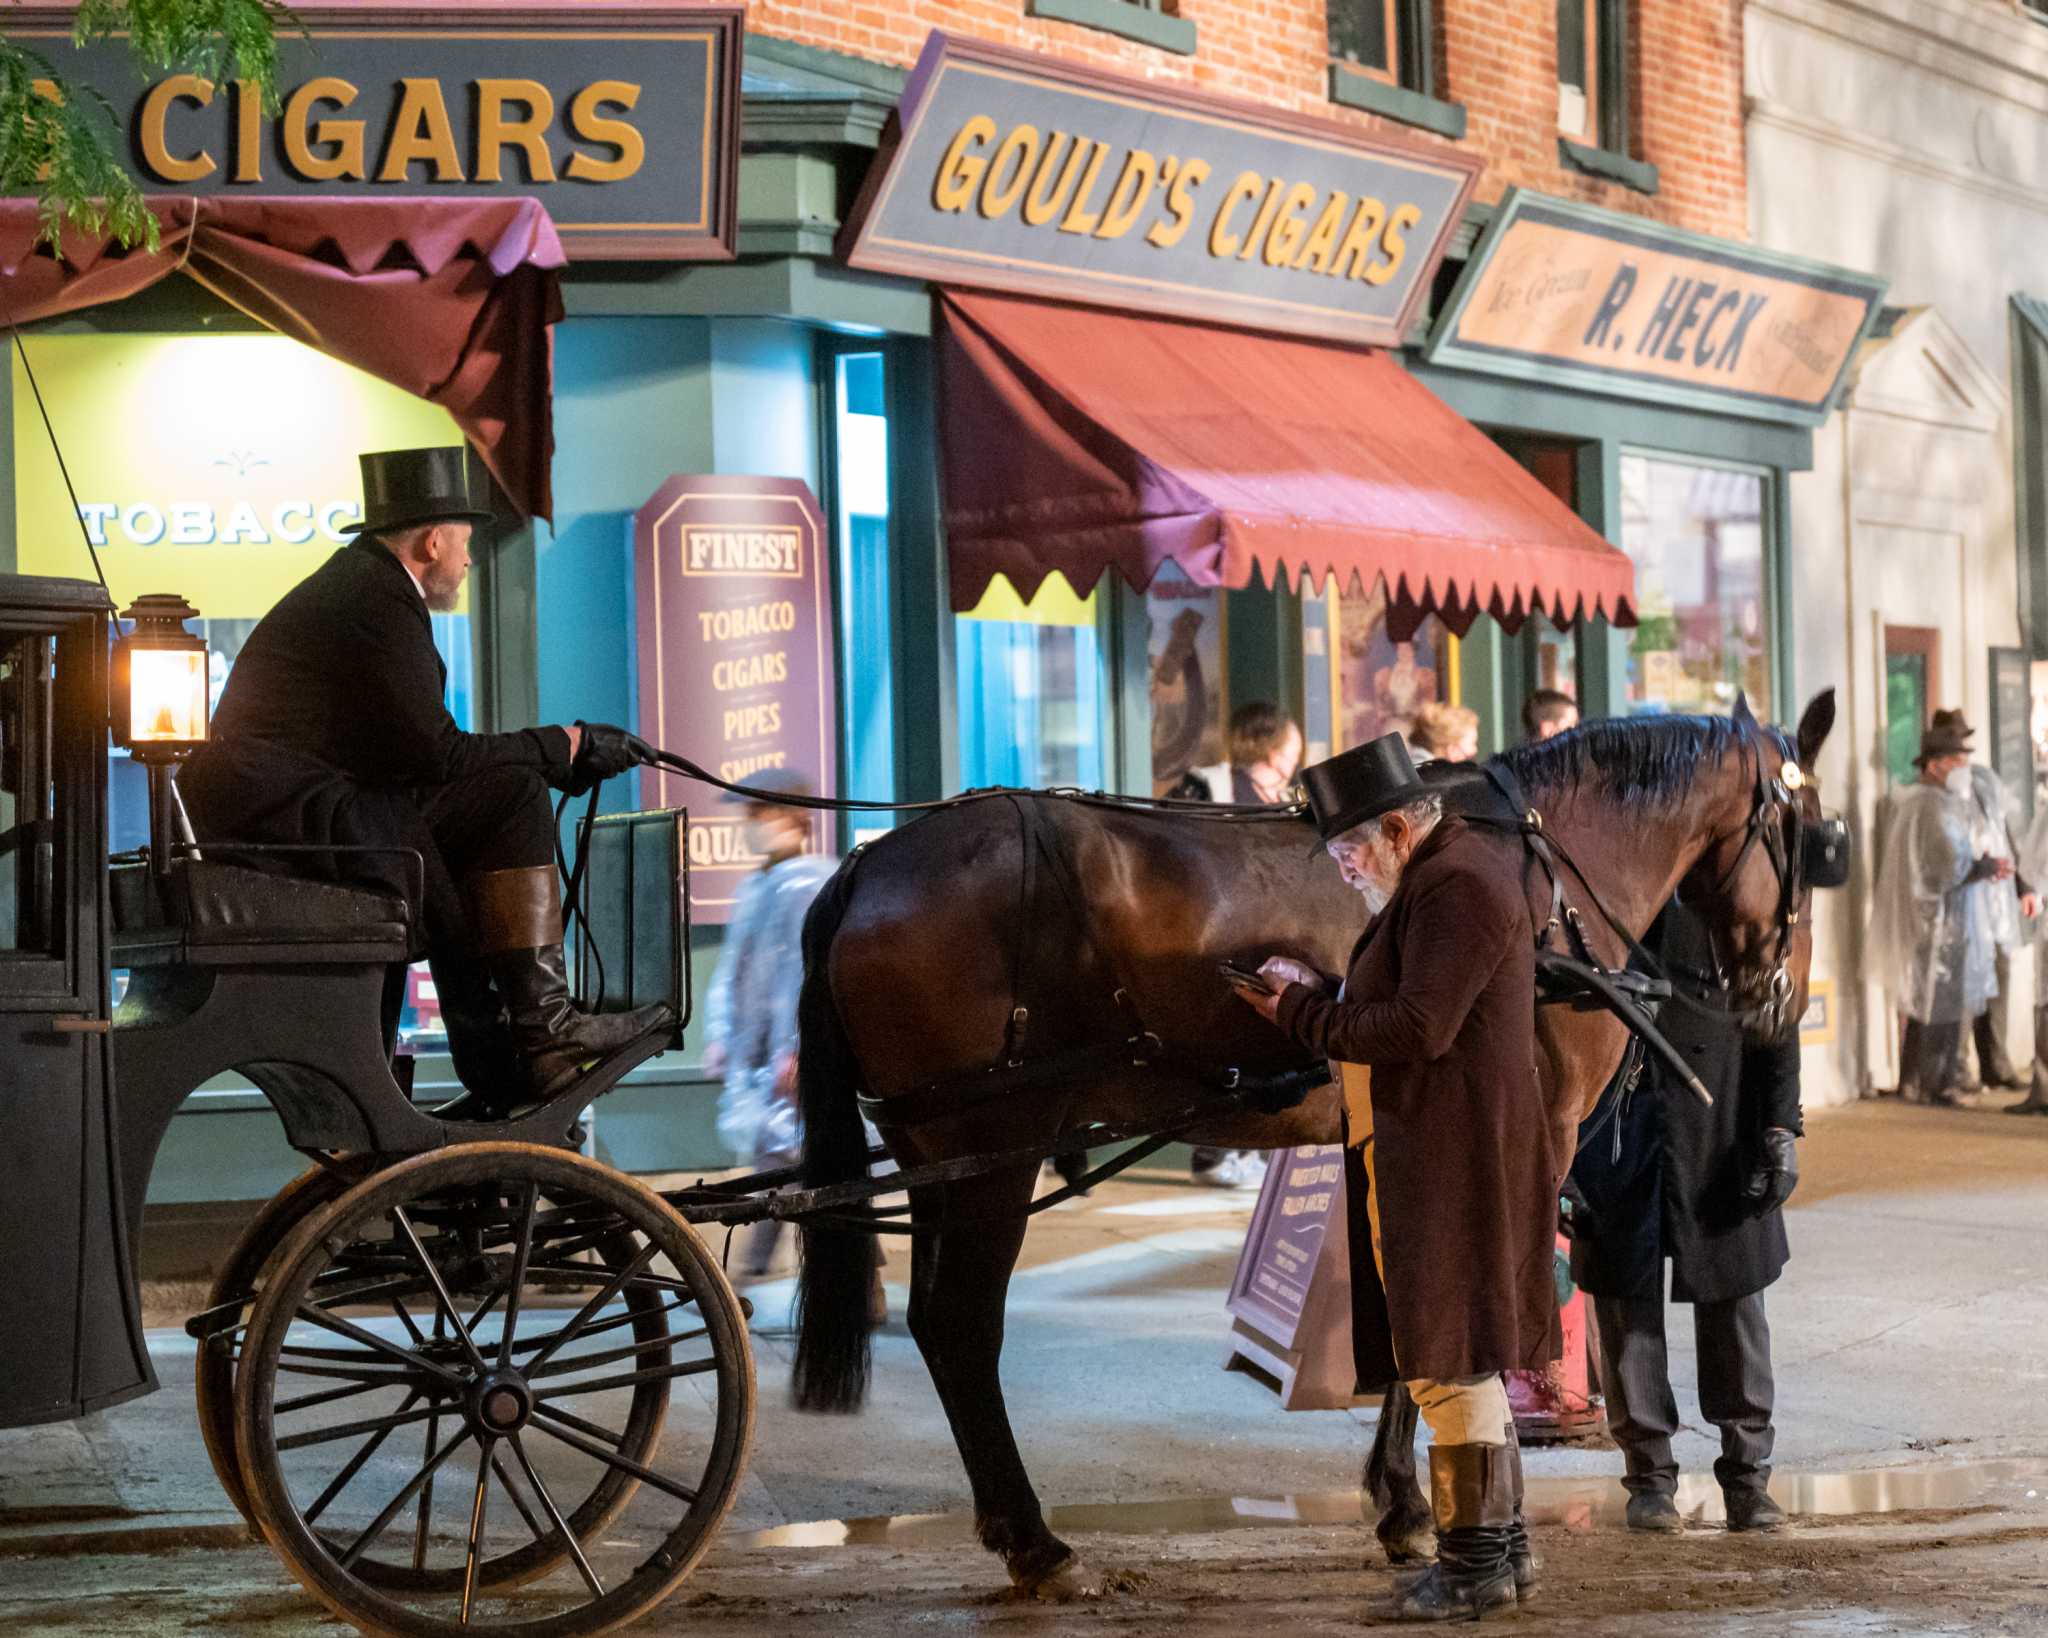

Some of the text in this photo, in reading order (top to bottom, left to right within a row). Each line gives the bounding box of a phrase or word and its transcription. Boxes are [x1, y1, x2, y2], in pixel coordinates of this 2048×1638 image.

[139, 74, 646, 184] CIGARS
[932, 115, 1422, 286] GOULD'S CIGARS
[1584, 264, 1638, 351] R.
[1635, 275, 1768, 373] HECK
[76, 501, 361, 545] TOBACC
[688, 532, 797, 571] FINEST
[698, 600, 796, 642] TOBACCO
[711, 652, 788, 691] CIGARS
[723, 702, 782, 741] PIPES
